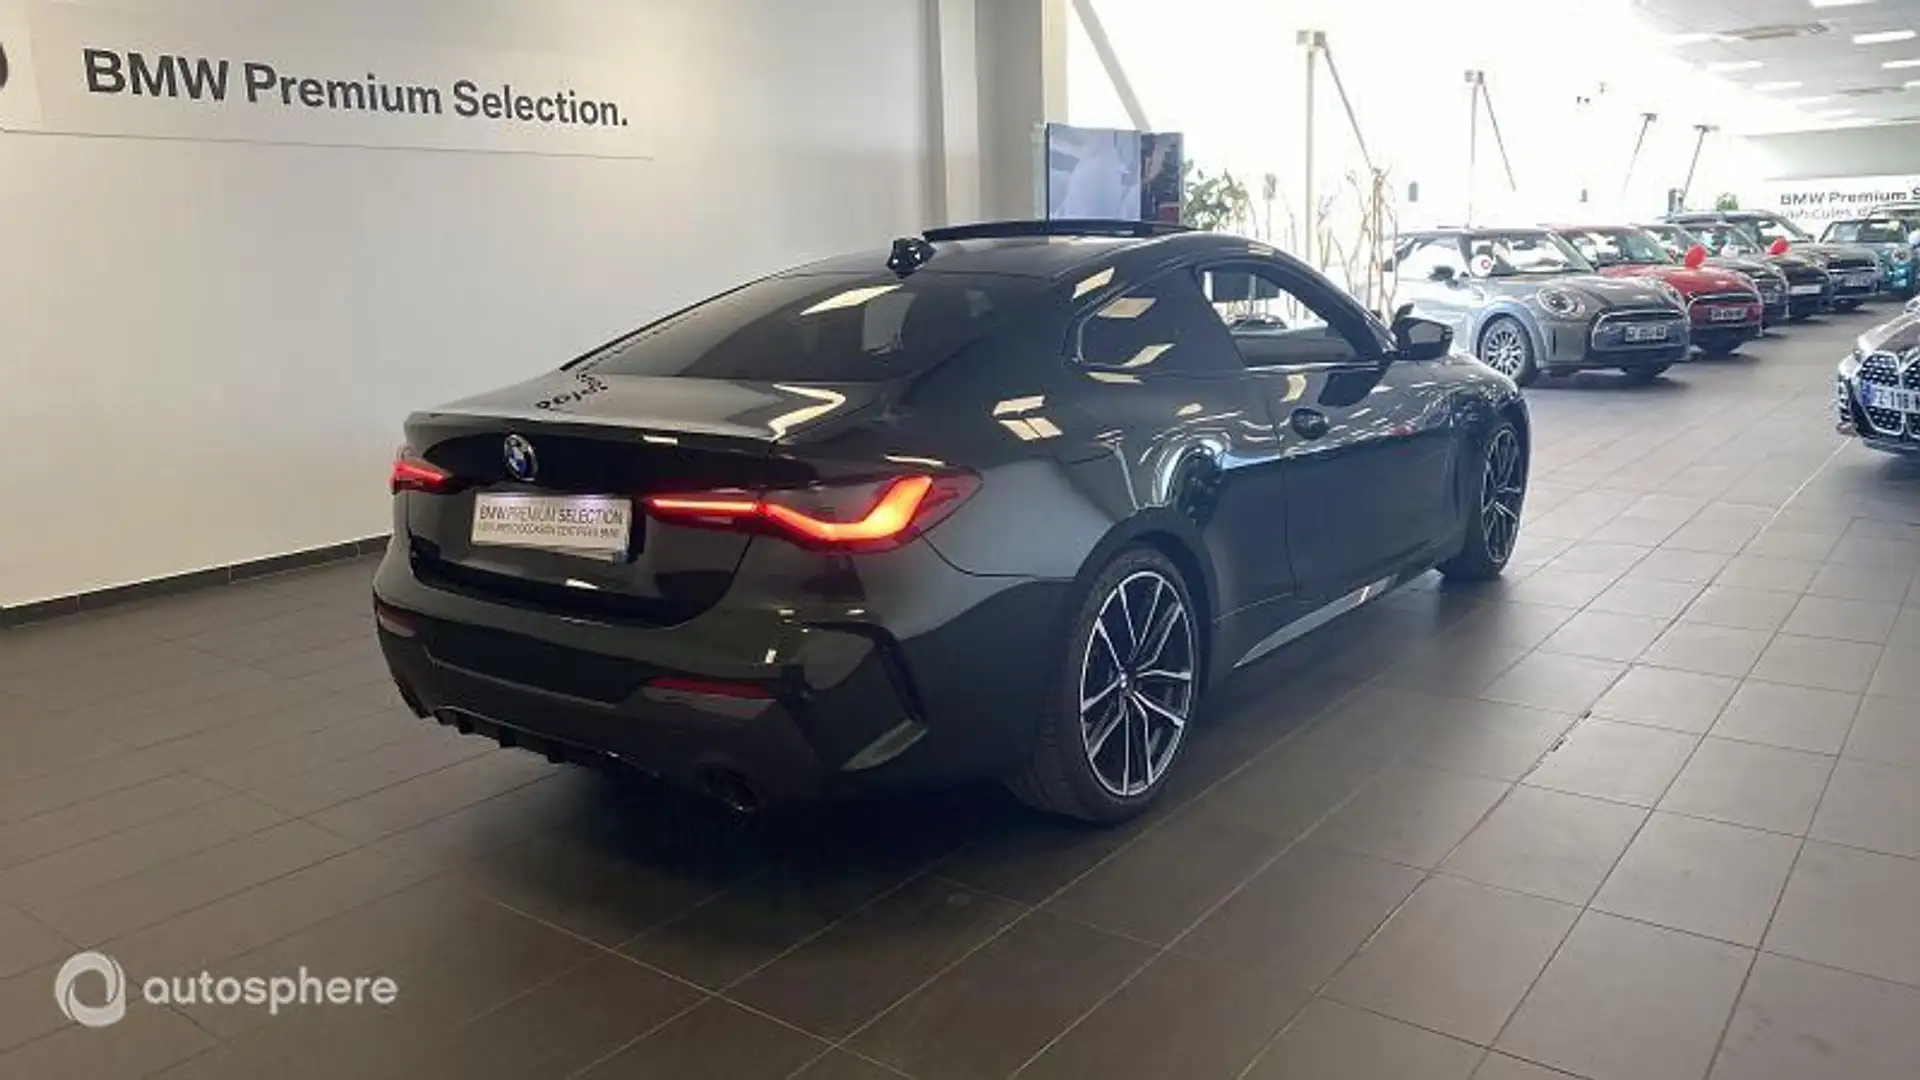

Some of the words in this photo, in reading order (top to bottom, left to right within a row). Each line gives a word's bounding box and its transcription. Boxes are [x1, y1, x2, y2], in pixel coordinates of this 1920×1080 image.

[83, 48, 229, 101] BMW
[244, 62, 443, 116] Premium
[453, 80, 629, 127] Selection.
[1780, 192, 1825, 205] BMW
[1829, 190, 1907, 203] Premium
[558, 507, 623, 525] SELECTION
